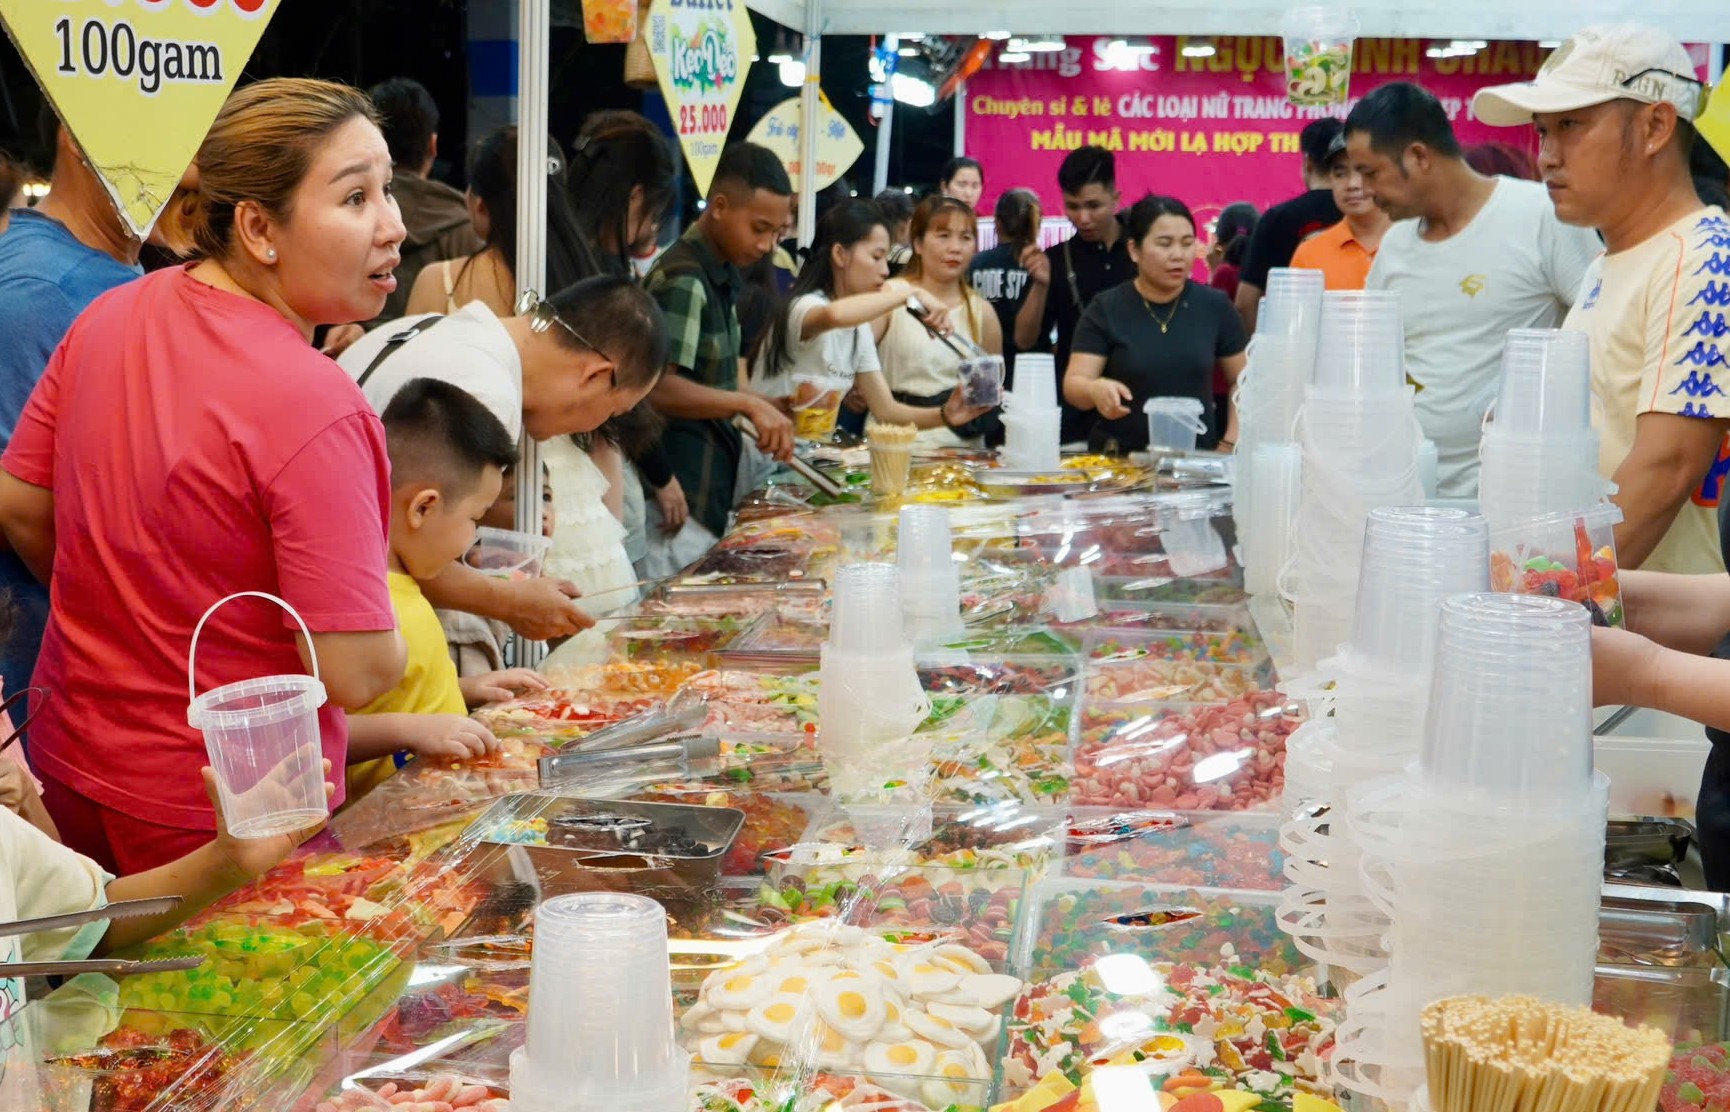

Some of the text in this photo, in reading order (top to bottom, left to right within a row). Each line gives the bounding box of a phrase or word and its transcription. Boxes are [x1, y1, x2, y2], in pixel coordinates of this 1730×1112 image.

[56, 19, 223, 93] 100gam
[680, 104, 727, 135] 25.000
[972, 95, 1044, 119] Chuyên
[1072, 95, 1087, 116] &
[1117, 91, 1154, 118] CÁC
[1157, 95, 1198, 122] LOẠI
[1181, 130, 1208, 156] LẠ
